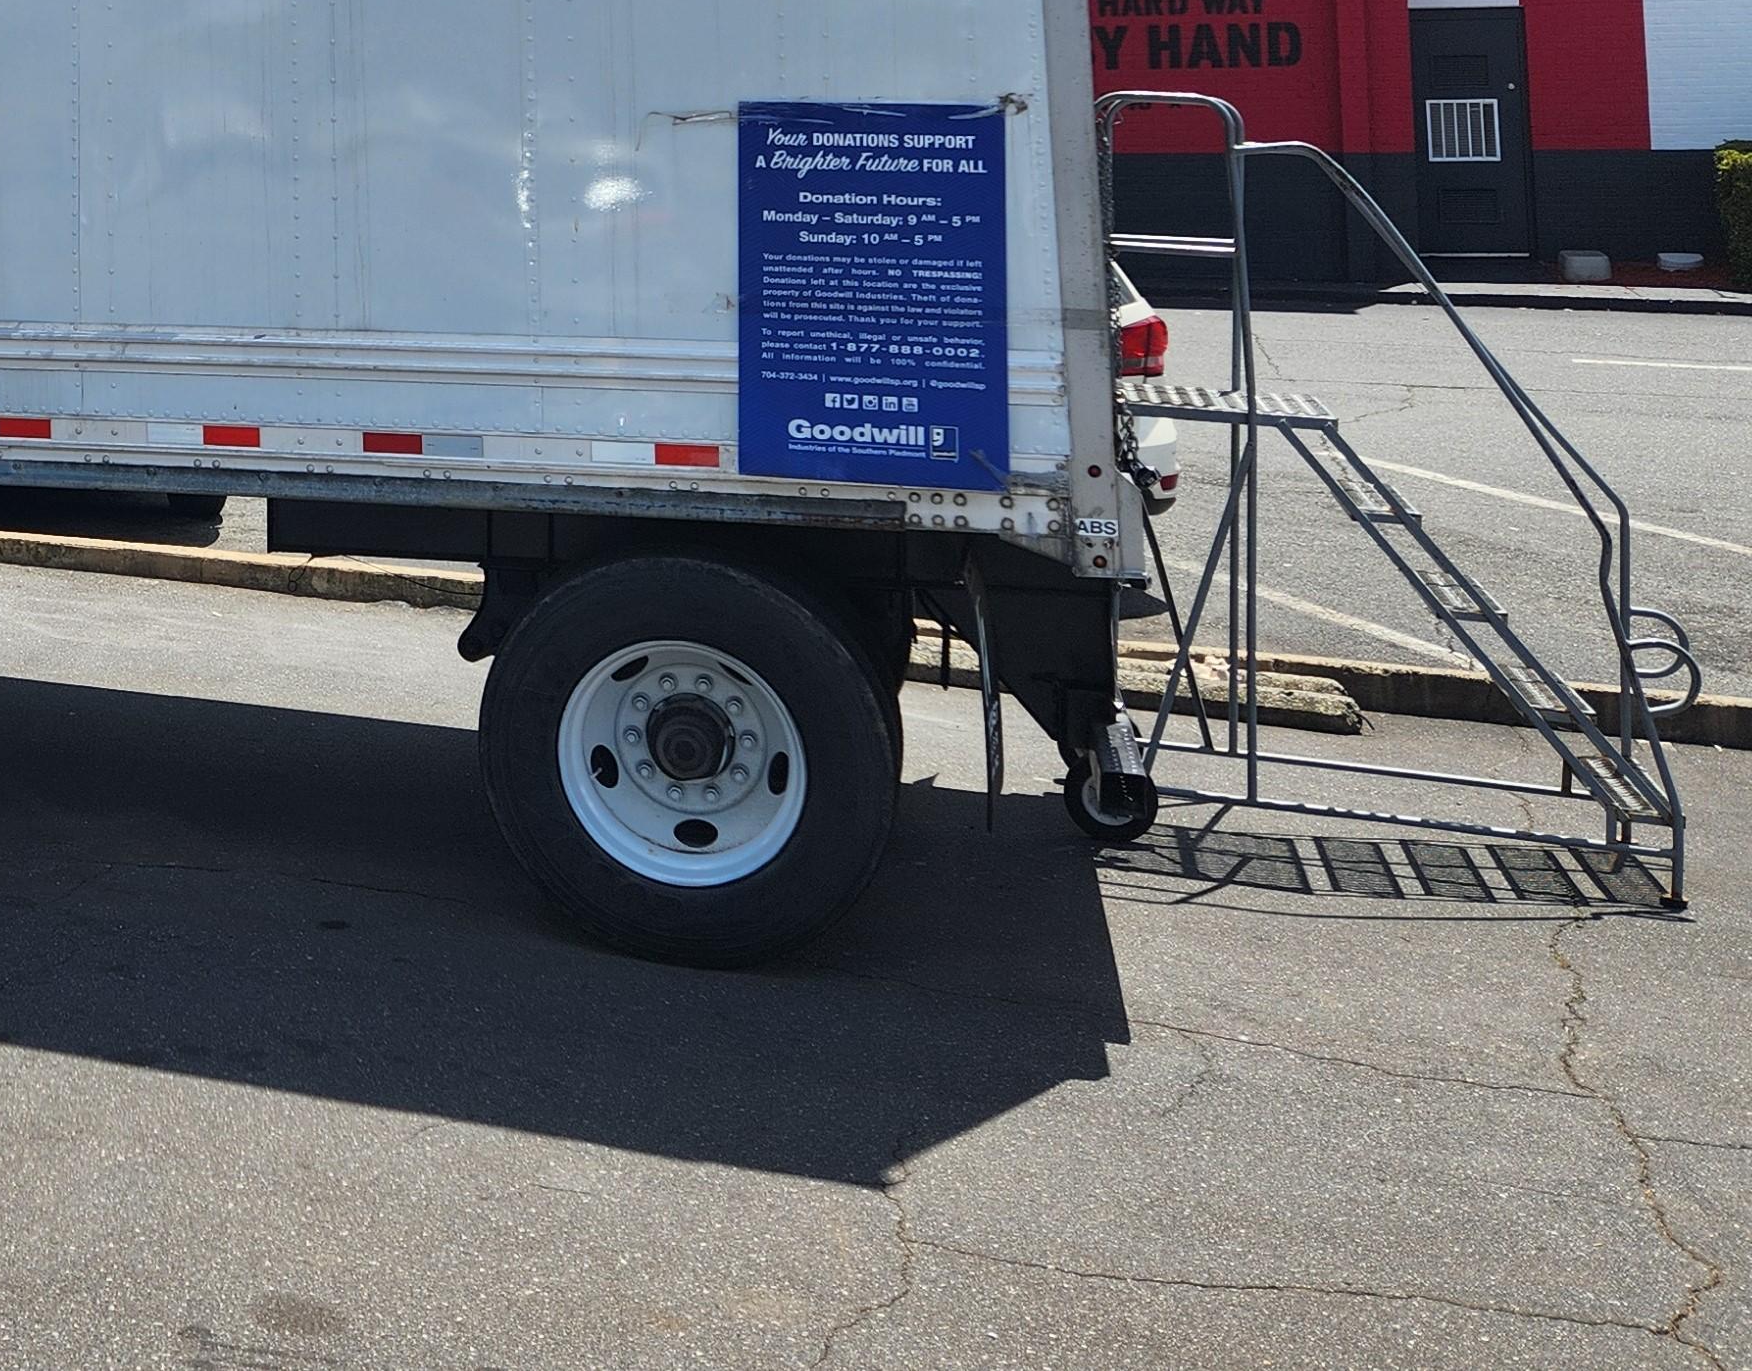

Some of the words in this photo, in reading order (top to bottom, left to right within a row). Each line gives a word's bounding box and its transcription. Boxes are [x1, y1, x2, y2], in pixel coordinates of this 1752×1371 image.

[1091, 25, 1128, 70] Y
[1148, 21, 1302, 70] HAND
[766, 128, 808, 147] Your
[812, 132, 899, 148] DONATIONS
[903, 134, 976, 149] SUPPORT
[755, 155, 766, 168] A
[770, 150, 852, 179] Brighter
[855, 151, 921, 172] Future
[922, 159, 953, 173] FOR
[958, 159, 988, 174] ALL
[799, 192, 878, 205] Donation
[882, 193, 942, 207] Hours:
[762, 210, 819, 225] Monday
[834, 212, 904, 227] Saturday:
[907, 215, 917, 226] 9
[921, 214, 936, 222] AM
[951, 215, 961, 227] 5
[965, 215, 981, 223] PM
[799, 231, 857, 246] Sunday:
[862, 232, 879, 244] 10
[883, 233, 898, 241] AM
[913, 234, 923, 245] 5
[762, 252, 783, 260] Your
[785, 253, 830, 262] donations
[832, 256, 851, 264] may
[867, 256, 897, 264] stolen
[911, 258, 954, 267] damaged
[762, 264, 813, 273] unattended
[822, 266, 844, 274] after
[850, 267, 879, 275] hours.
[887, 268, 902, 276] NO
[911, 269, 982, 279] TRESPASSING!
[763, 276, 806, 284] Donations
[862, 280, 899, 288] location
[939, 283, 982, 291] exclusive
[762, 288, 800, 297] property
[814, 290, 853, 298] Goodwill
[855, 291, 907, 300] Industries.
[910, 293, 936, 302] Theft
[953, 295, 982, 304] dona-
[763, 299, 786, 307] tions
[788, 300, 809, 308] from
[810, 301, 827, 309] this
[793, 313, 845, 322] prosecuted.
[847, 315, 876, 323] Thank
[879, 317, 897, 325] you
[916, 319, 938, 327] your
[760, 327, 771, 335] To
[777, 329, 804, 337] report
[761, 340, 790, 349] please
[793, 342, 827, 350] contact
[761, 351, 773, 359] All
[782, 352, 836, 362] information
[844, 355, 861, 363] will
[890, 357, 916, 366] 100%
[761, 370, 817, 381] 704-372-3434
[788, 419, 925, 446] Goodwill
[788, 443, 825, 452] Industries
[827, 443, 836, 452] of
[837, 444, 850, 453] the
[851, 446, 887, 455] Southern
[888, 448, 926, 457] Piedmont
[1078, 520, 1117, 535] ABS
